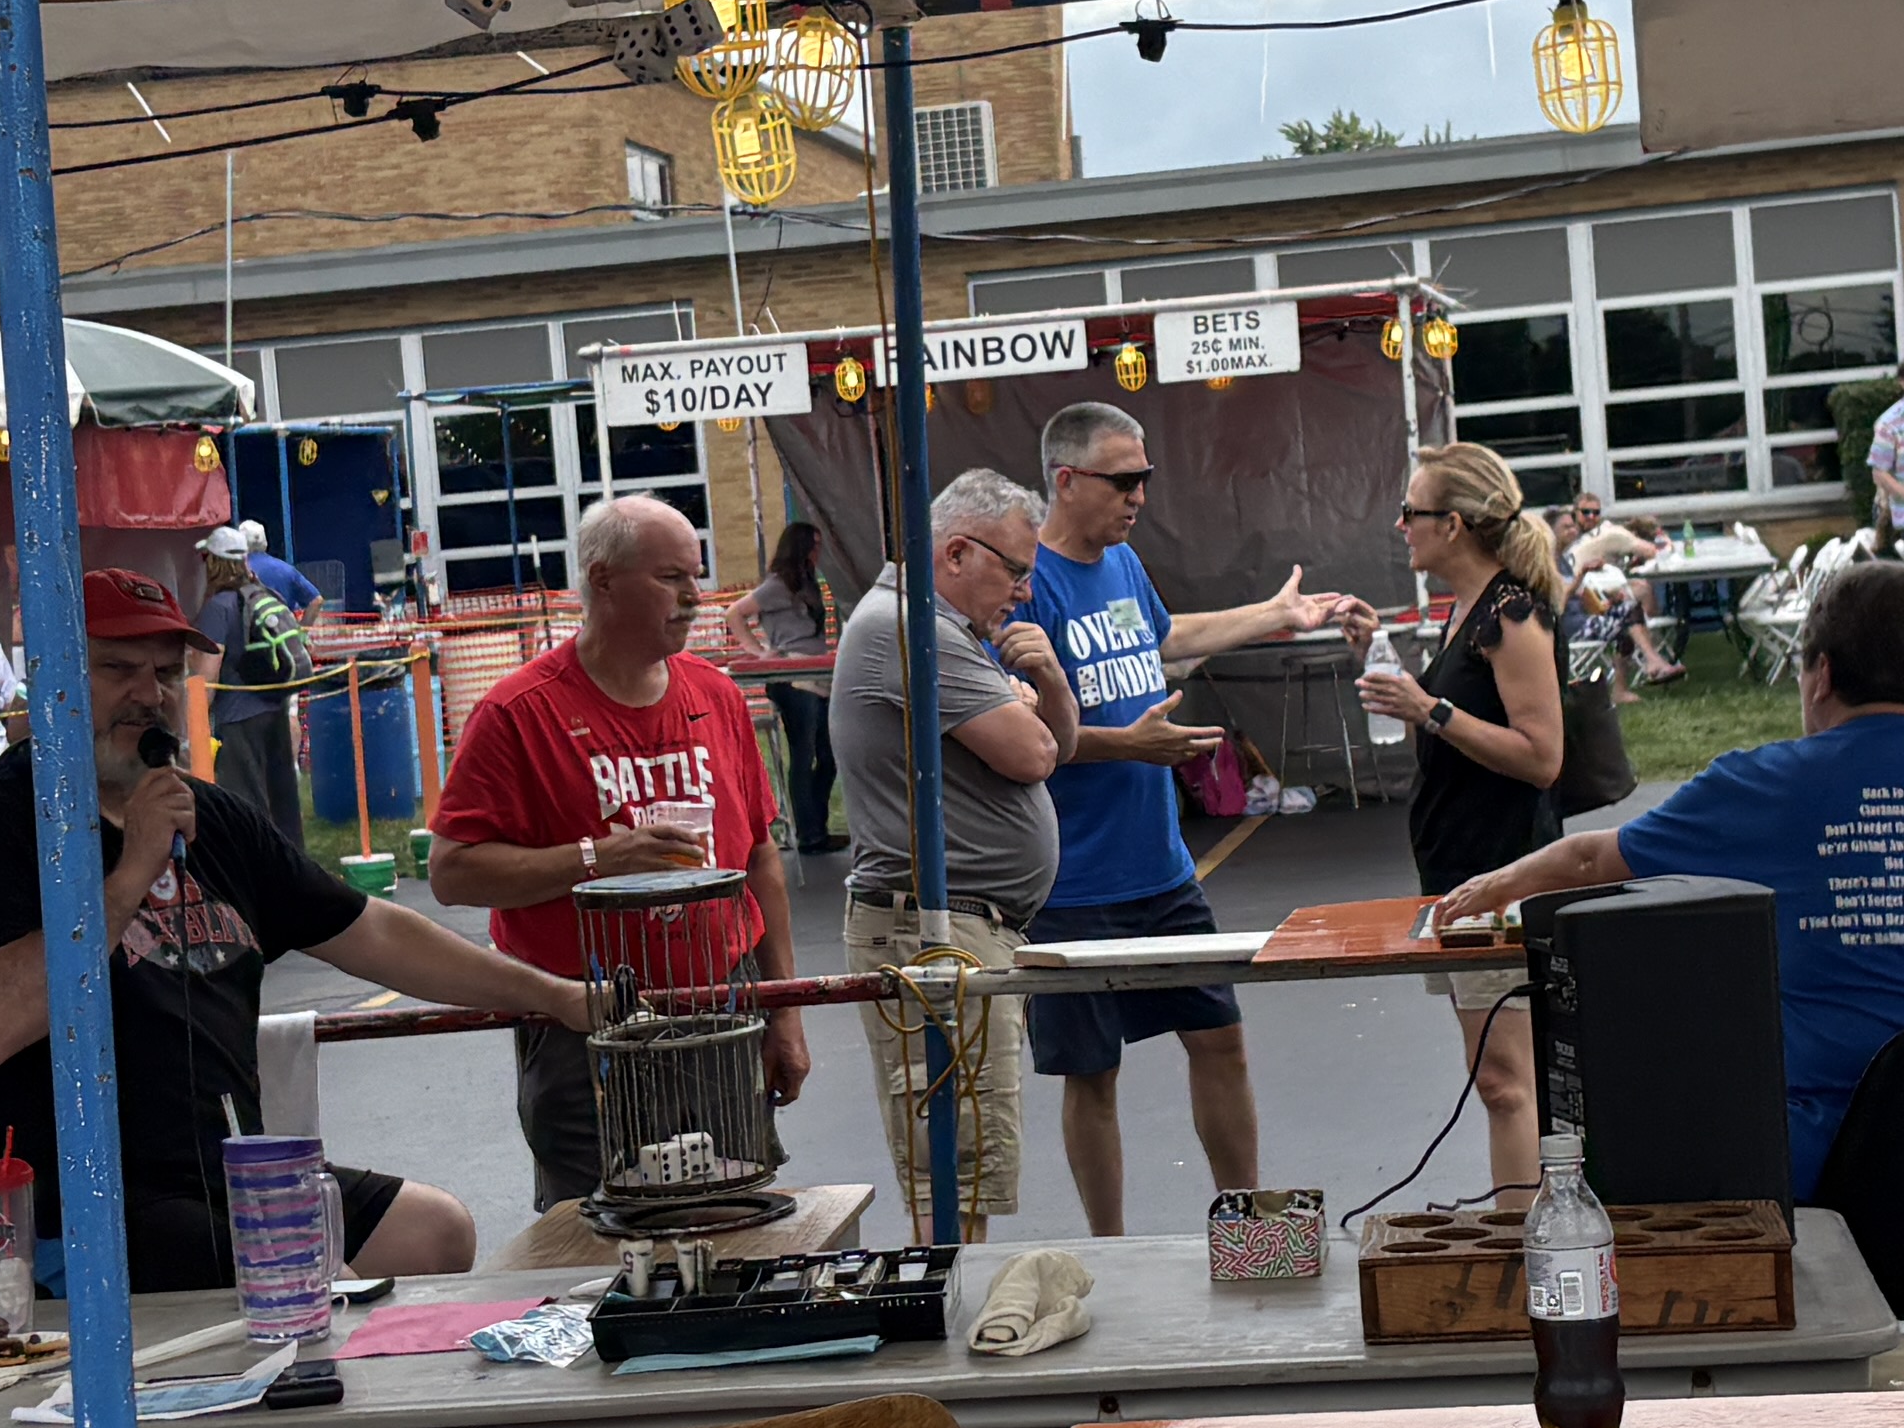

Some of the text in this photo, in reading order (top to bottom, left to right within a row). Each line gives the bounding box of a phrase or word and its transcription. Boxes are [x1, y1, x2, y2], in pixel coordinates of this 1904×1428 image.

[1193, 310, 1261, 335] BETS
[889, 328, 1076, 375] AINBOW
[1191, 336, 1265, 355] 25¢ MIN.
[621, 352, 788, 384] MAX. PAYOUT
[645, 381, 775, 416] $10/DAY
[590, 745, 717, 821] BATTLE
